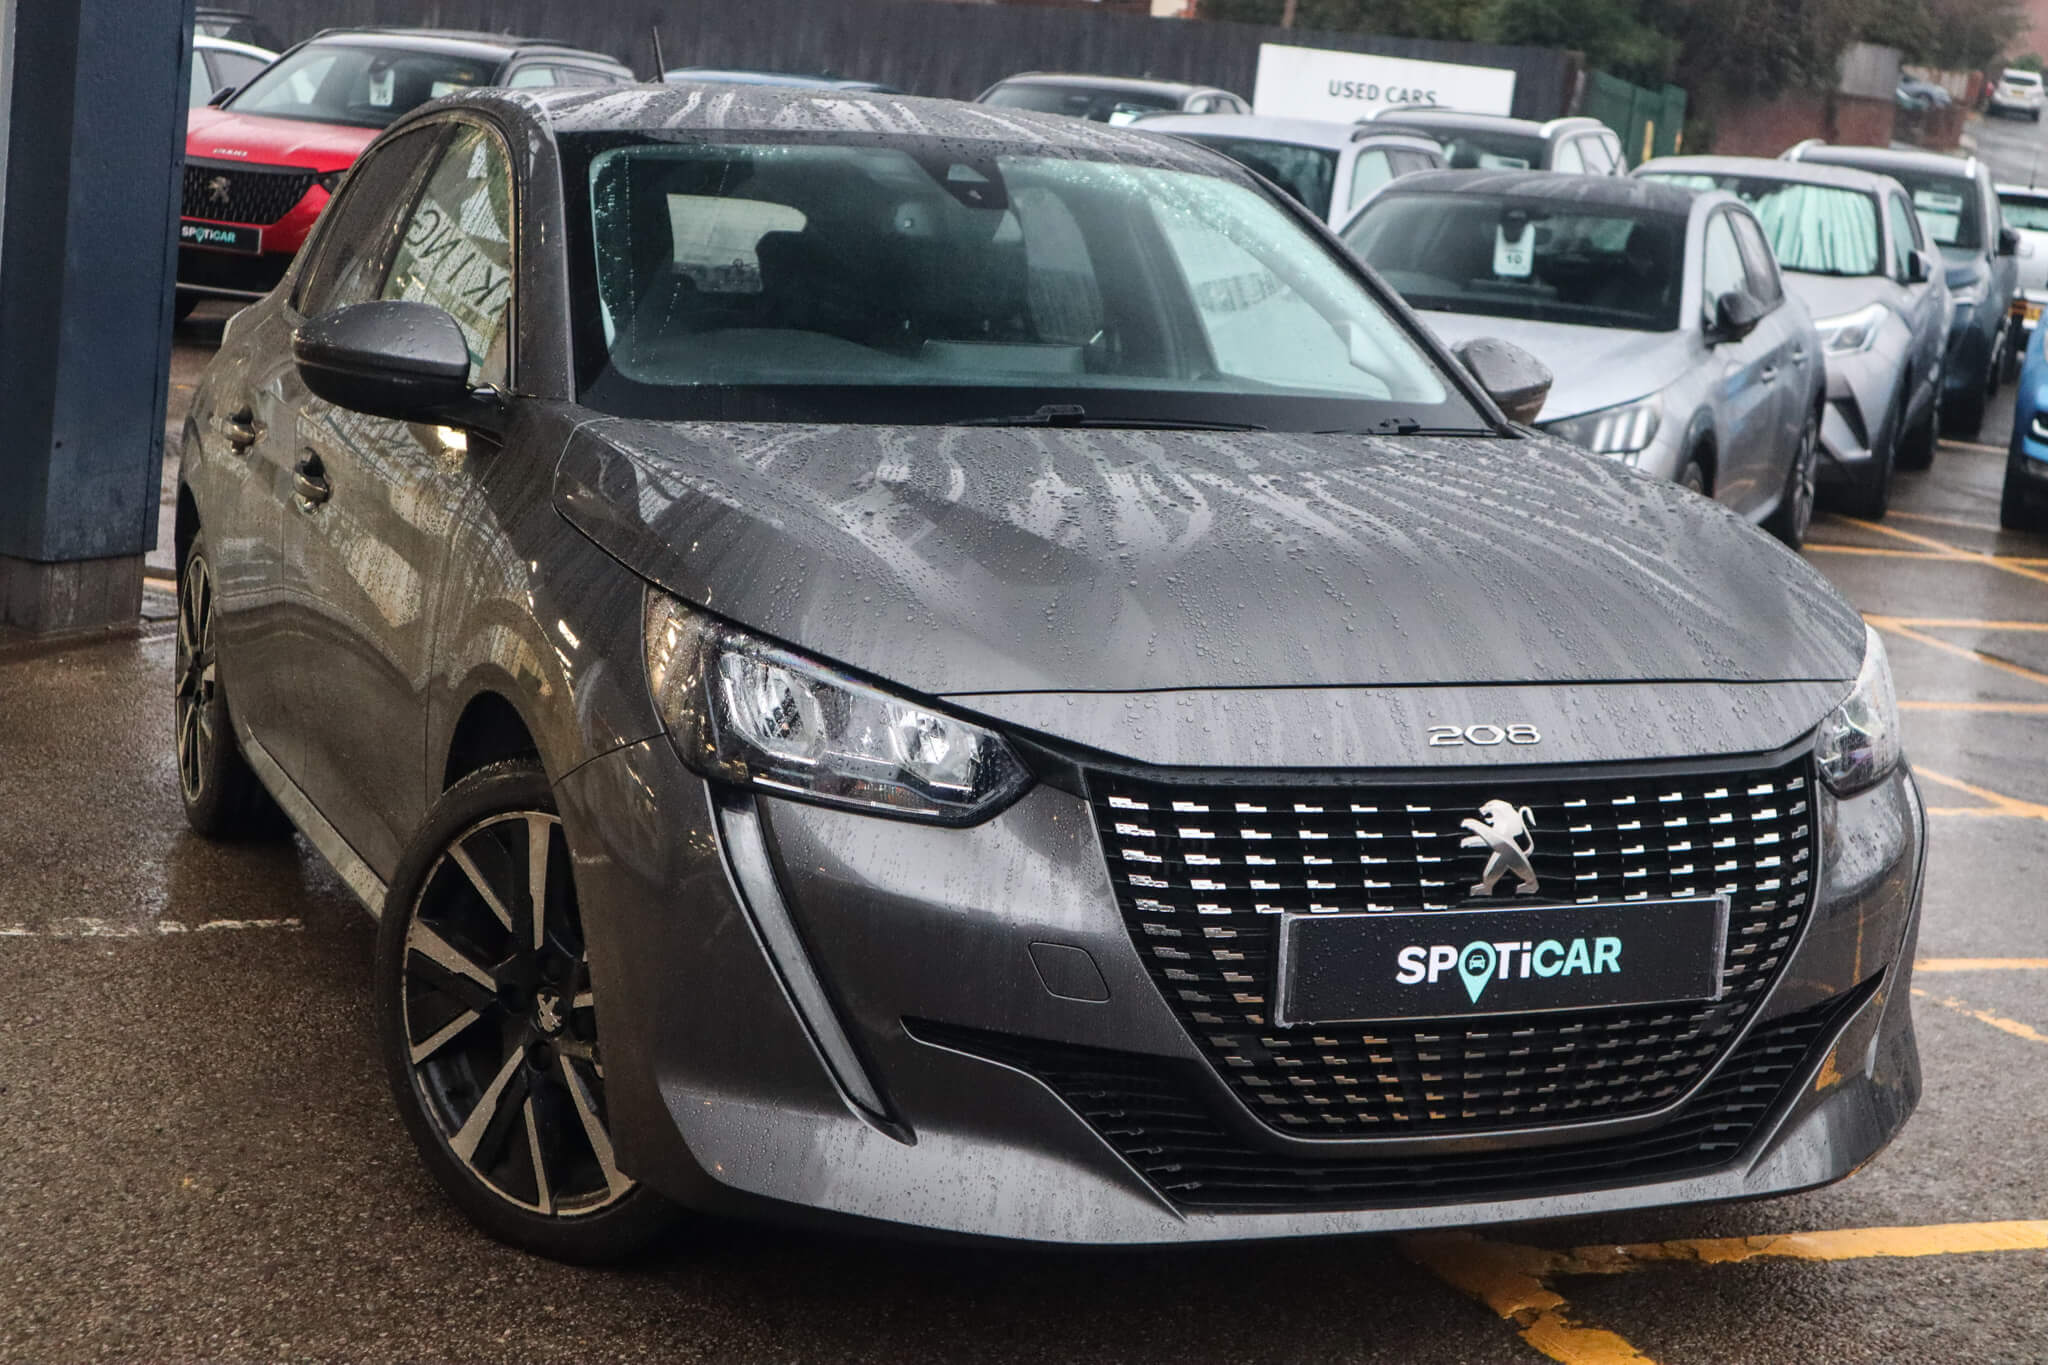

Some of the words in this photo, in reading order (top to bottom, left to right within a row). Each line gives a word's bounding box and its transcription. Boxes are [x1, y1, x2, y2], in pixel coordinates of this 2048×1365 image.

[1328, 79, 1379, 101] USED
[1384, 86, 1437, 107] CARS
[1427, 724, 1542, 747] 208
